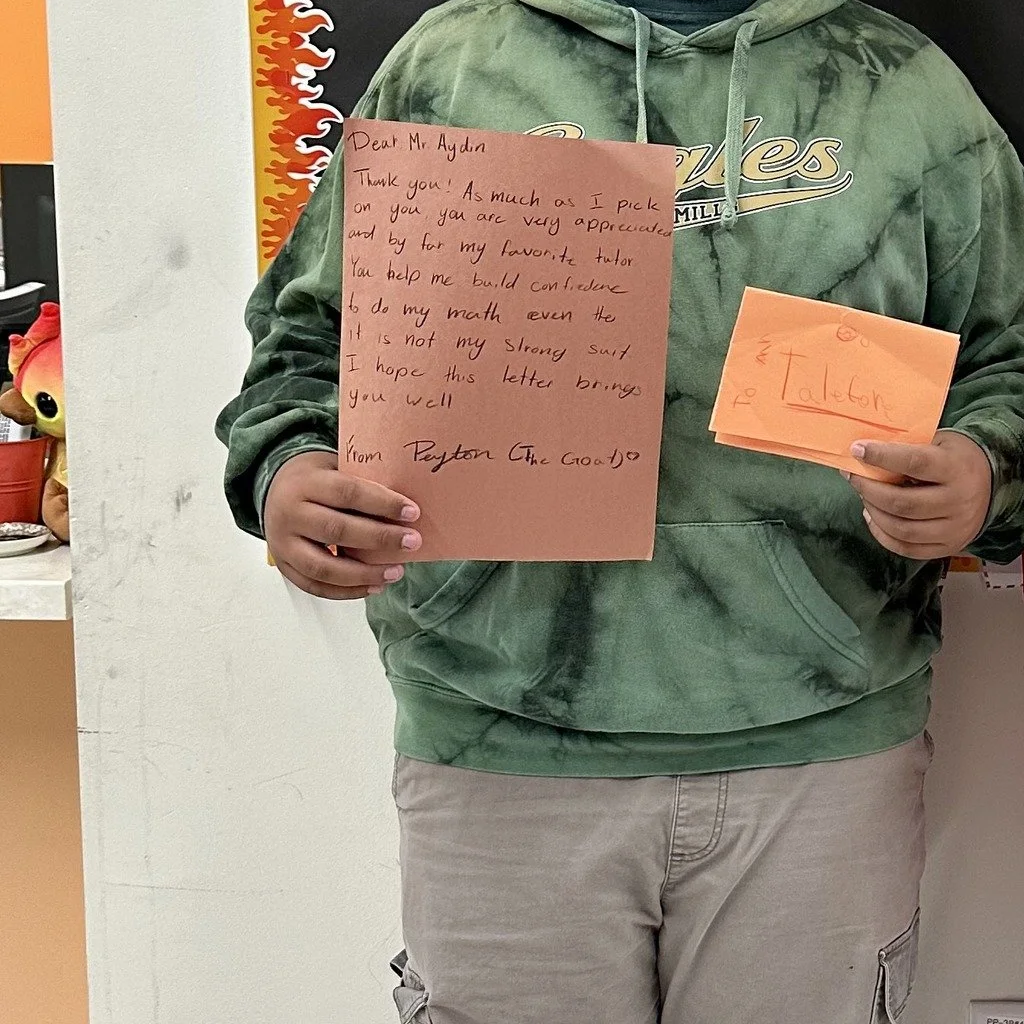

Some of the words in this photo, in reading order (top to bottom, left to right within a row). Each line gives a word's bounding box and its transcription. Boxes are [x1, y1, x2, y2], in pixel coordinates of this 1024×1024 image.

[347, 130, 397, 153] Dear
[353, 167, 400, 187] Thank
[463, 181, 483, 202] As
[490, 189, 540, 208] much
[554, 197, 575, 209] as
[590, 193, 603, 210] I
[617, 196, 660, 214] pick
[354, 201, 372, 215] on
[437, 207, 466, 227] you
[476, 211, 506, 224] are
[523, 214, 562, 236] very
[348, 224, 376, 241] and
[388, 232, 407, 254] by
[460, 241, 487, 265] my
[500, 239, 577, 266] favorite
[594, 247, 634, 267] tutor
[351, 254, 374, 278] You
[387, 261, 420, 286] help
[430, 273, 455, 286] me
[472, 273, 519, 289] build
[348, 292, 359, 314] to
[371, 297, 389, 314] do
[403, 304, 431, 327] my
[446, 301, 502, 325] math
[349, 323, 361, 341] it
[378, 332, 391, 346] is
[405, 330, 436, 348] not
[457, 336, 487, 362] my
[504, 337, 567, 363] strong
[346, 353, 360, 373] I
[376, 357, 425, 382] hope
[443, 365, 475, 384] this
[501, 365, 554, 389] letter
[575, 375, 642, 399] brings
[348, 388, 386, 410] you
[406, 392, 452, 410] well
[403, 440, 497, 474] Peyton
